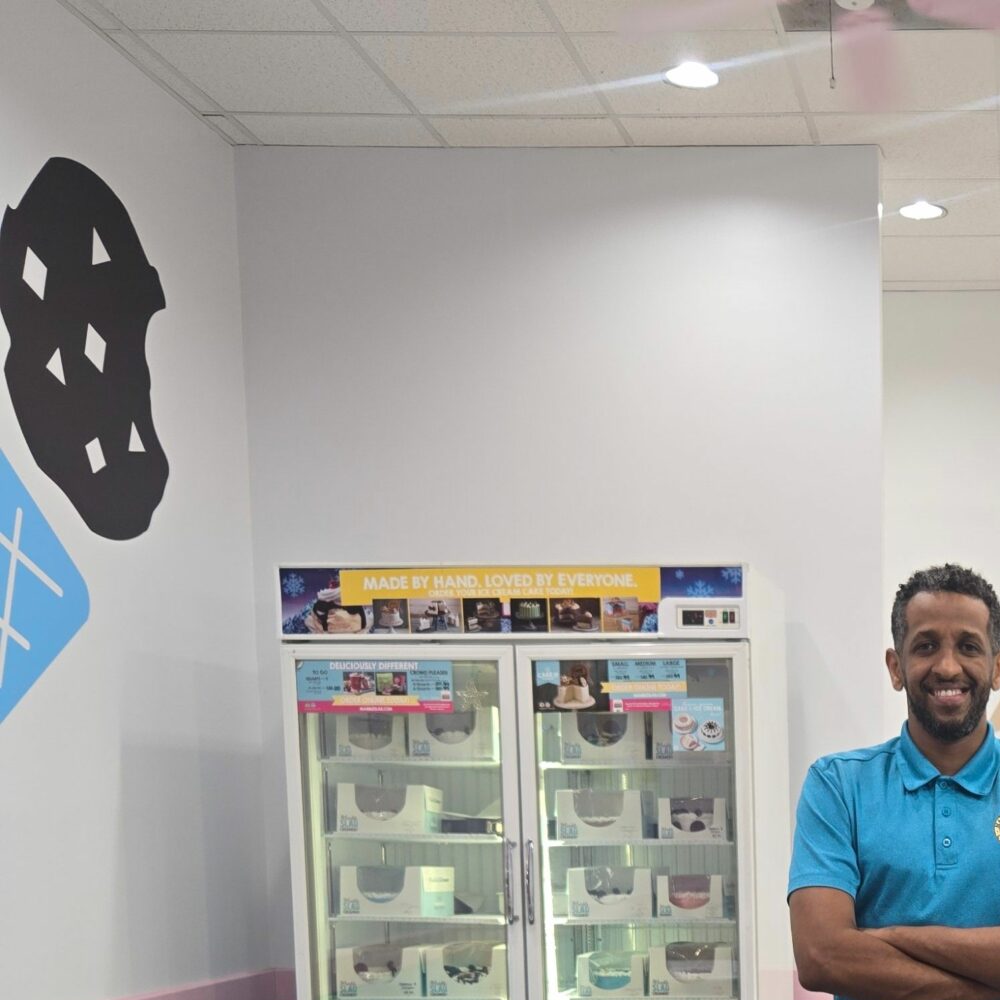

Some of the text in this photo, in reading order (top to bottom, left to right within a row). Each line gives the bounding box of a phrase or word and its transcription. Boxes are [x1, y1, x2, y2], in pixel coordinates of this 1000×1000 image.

[363, 573, 638, 590] MADE BY HAND. LOVED BY EVERYONE.
[329, 661, 419, 670] DELICIOUSLY DIFFERENT
